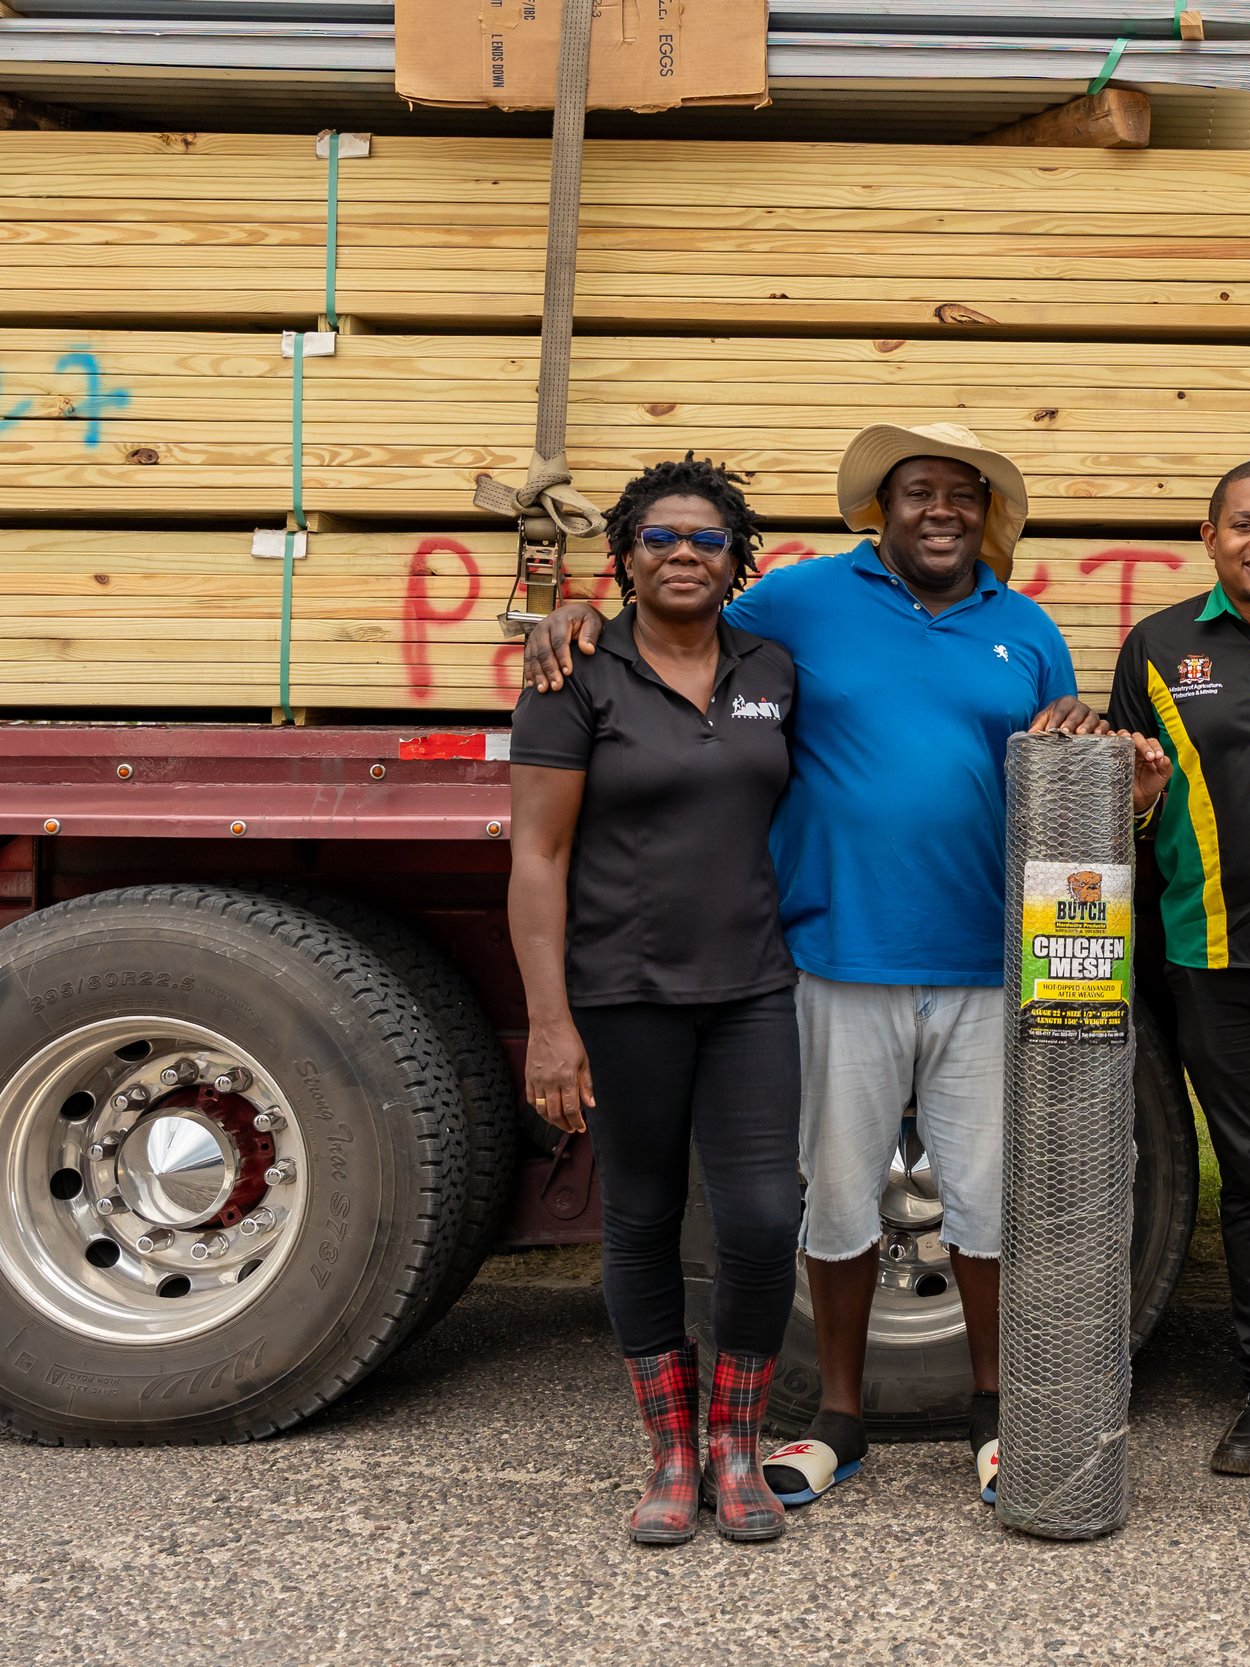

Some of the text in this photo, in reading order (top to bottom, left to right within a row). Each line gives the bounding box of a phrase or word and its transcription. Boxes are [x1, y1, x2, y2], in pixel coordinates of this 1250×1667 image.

[491, 41, 503, 62] ENDS
[659, 34, 674, 77] EGGS
[491, 64, 504, 88] DOWN
[1057, 901, 1106, 921] BUTCH
[1033, 936, 1124, 958] CHICKEN
[1050, 957, 1112, 978] MESH
[30, 970, 196, 1013] 295/80R22.5
[1082, 984, 1115, 992] GALVANIZED
[310, 1191, 350, 1290] S737
